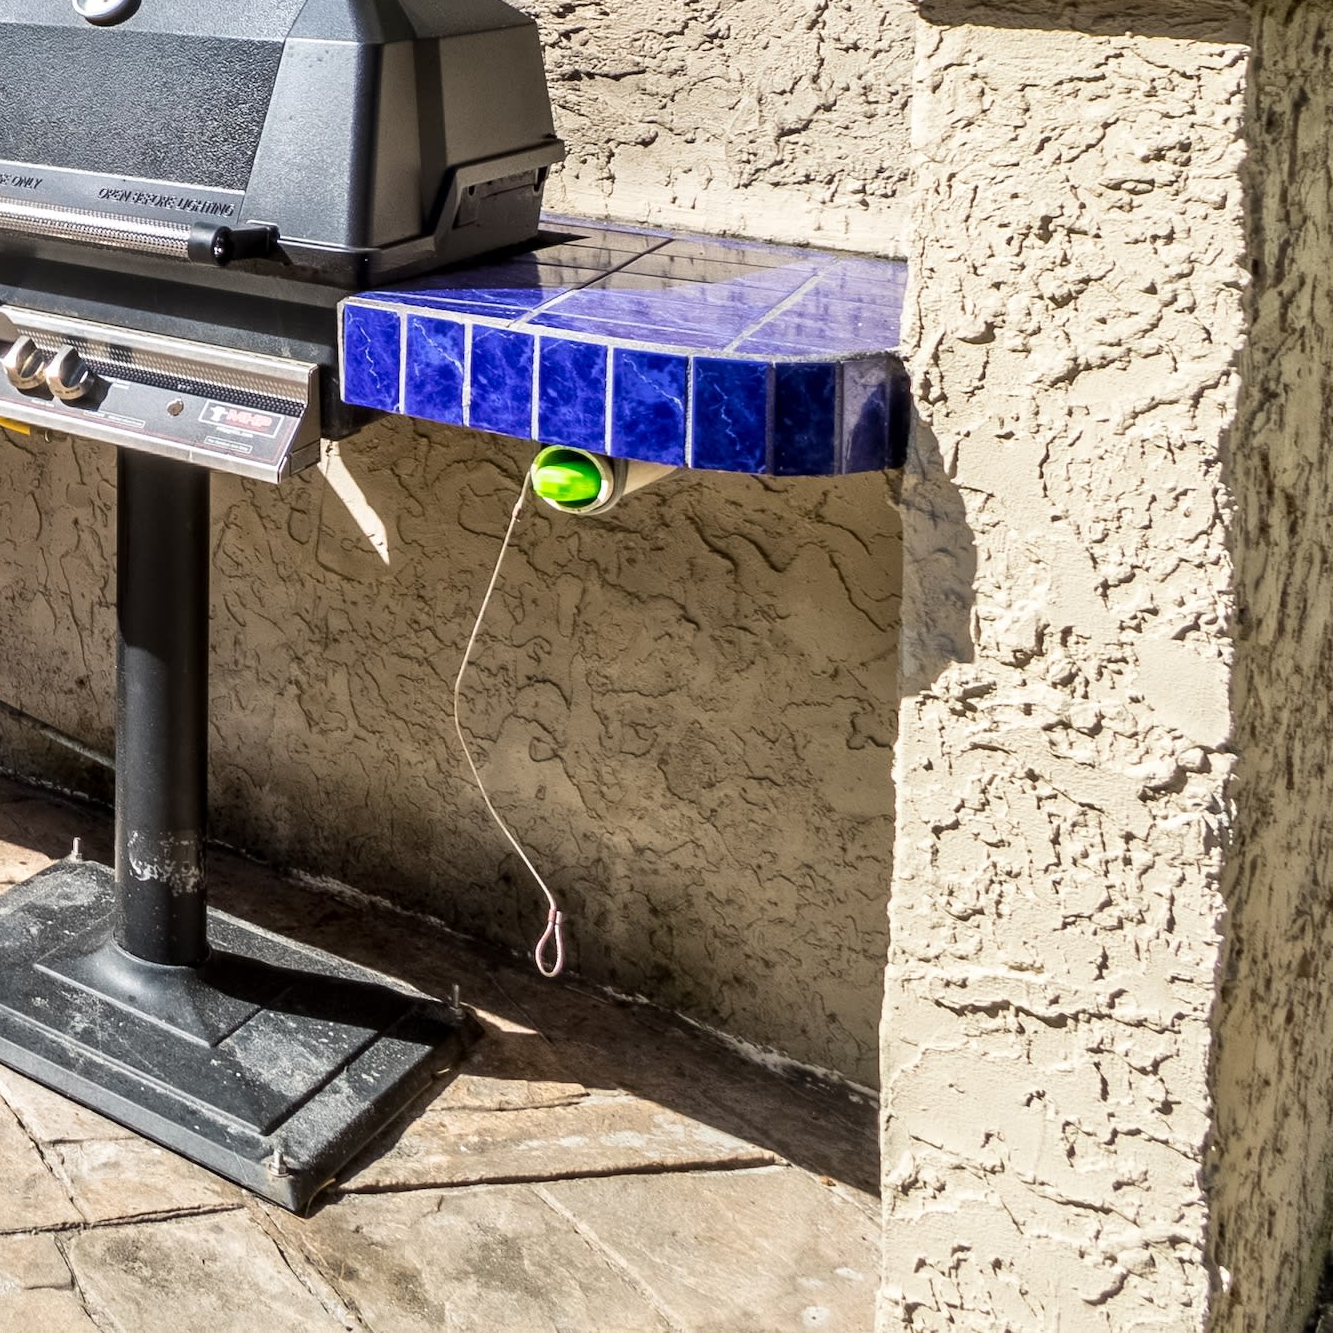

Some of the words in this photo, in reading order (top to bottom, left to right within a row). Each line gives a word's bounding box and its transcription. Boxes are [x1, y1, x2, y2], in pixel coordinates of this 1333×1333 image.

[11, 175, 43, 190] ONLY
[98, 188, 132, 202] OPEN
[132, 191, 177, 209] BEFORE
[176, 197, 236, 218] LIGHTING
[226, 409, 273, 428] MHP
